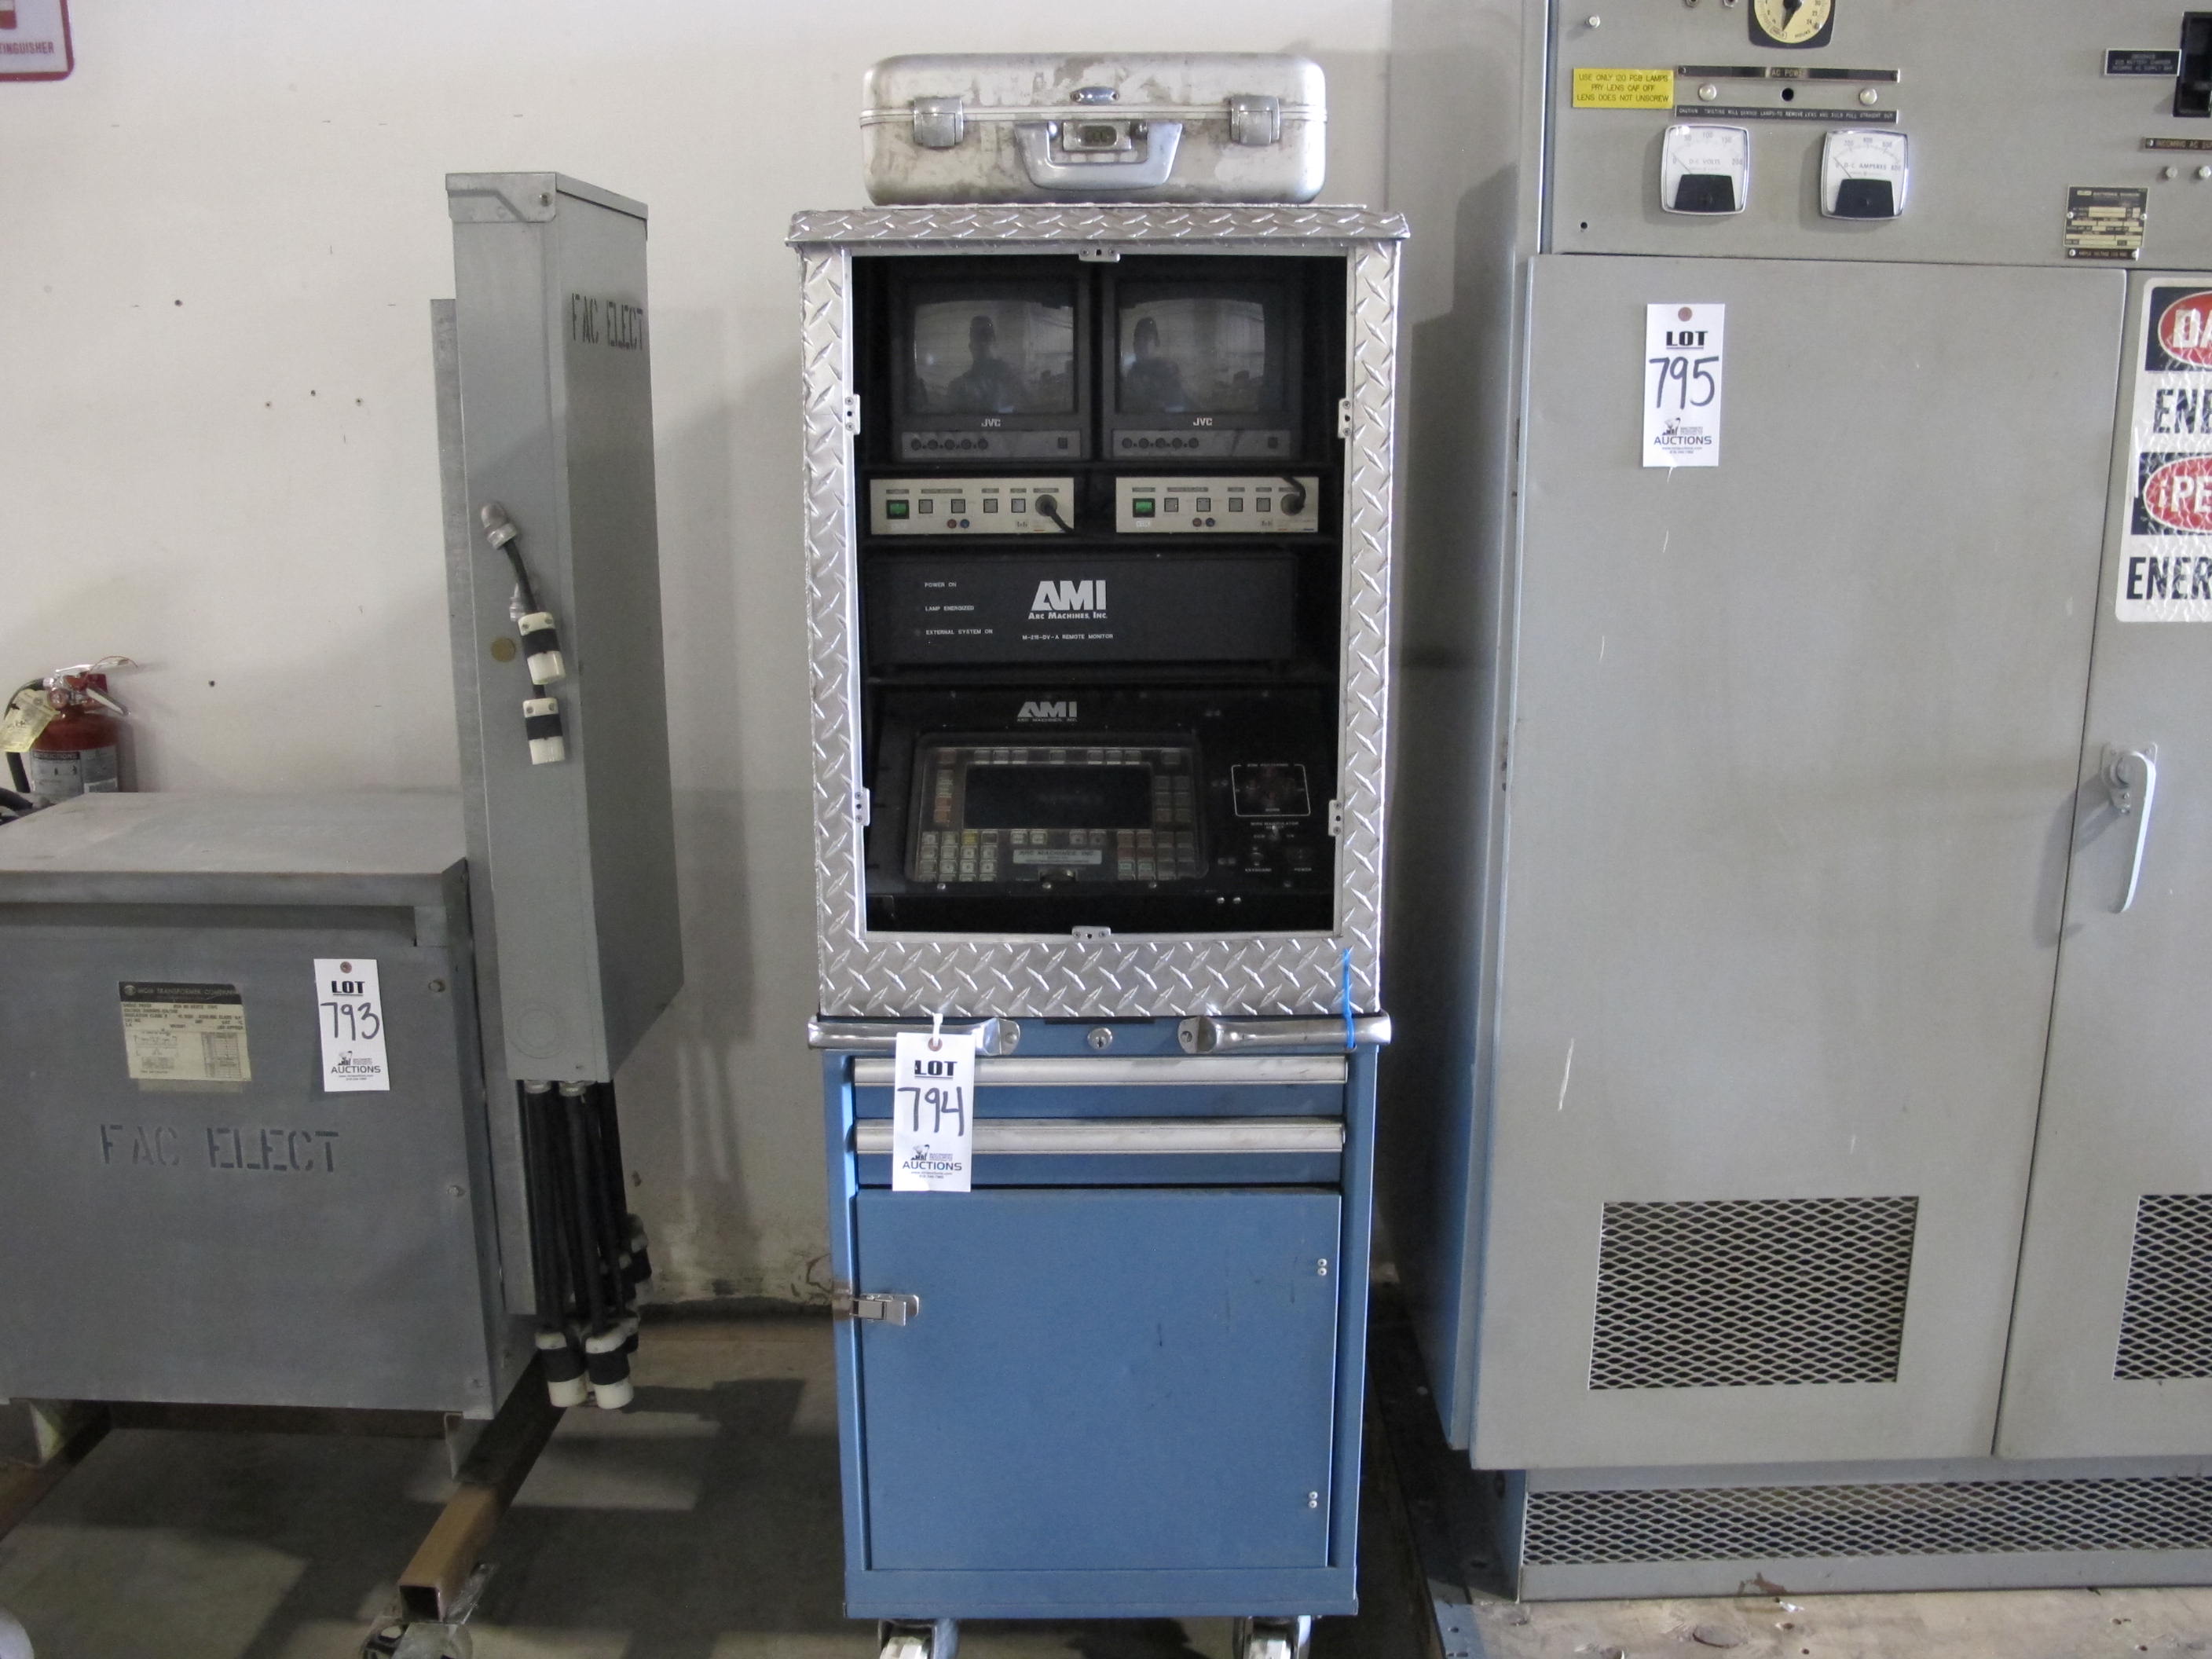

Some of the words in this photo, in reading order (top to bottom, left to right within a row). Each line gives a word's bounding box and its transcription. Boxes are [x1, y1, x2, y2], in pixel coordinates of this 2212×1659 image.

[571, 292, 599, 344] FAC
[606, 300, 643, 350] ELECT
[1666, 331, 1708, 346] LOT
[1649, 356, 1719, 410] 795
[981, 418, 1001, 427] JVC
[1192, 418, 1213, 427] JVC
[1654, 436, 1712, 445] AUCTIONS
[2126, 557, 2212, 599] ENER
[1031, 580, 1107, 610] AMI
[1017, 701, 1078, 717] AMI
[331, 980, 365, 994] LOT
[320, 1002, 380, 1042] 793
[331, 1065, 382, 1074] AUCTIONS
[914, 1060, 958, 1076] LOT
[897, 1086, 965, 1137] 794
[101, 1123, 179, 1166] FAC
[207, 1127, 339, 1173] ELECT
[903, 1161, 962, 1171] AUCTIONS
